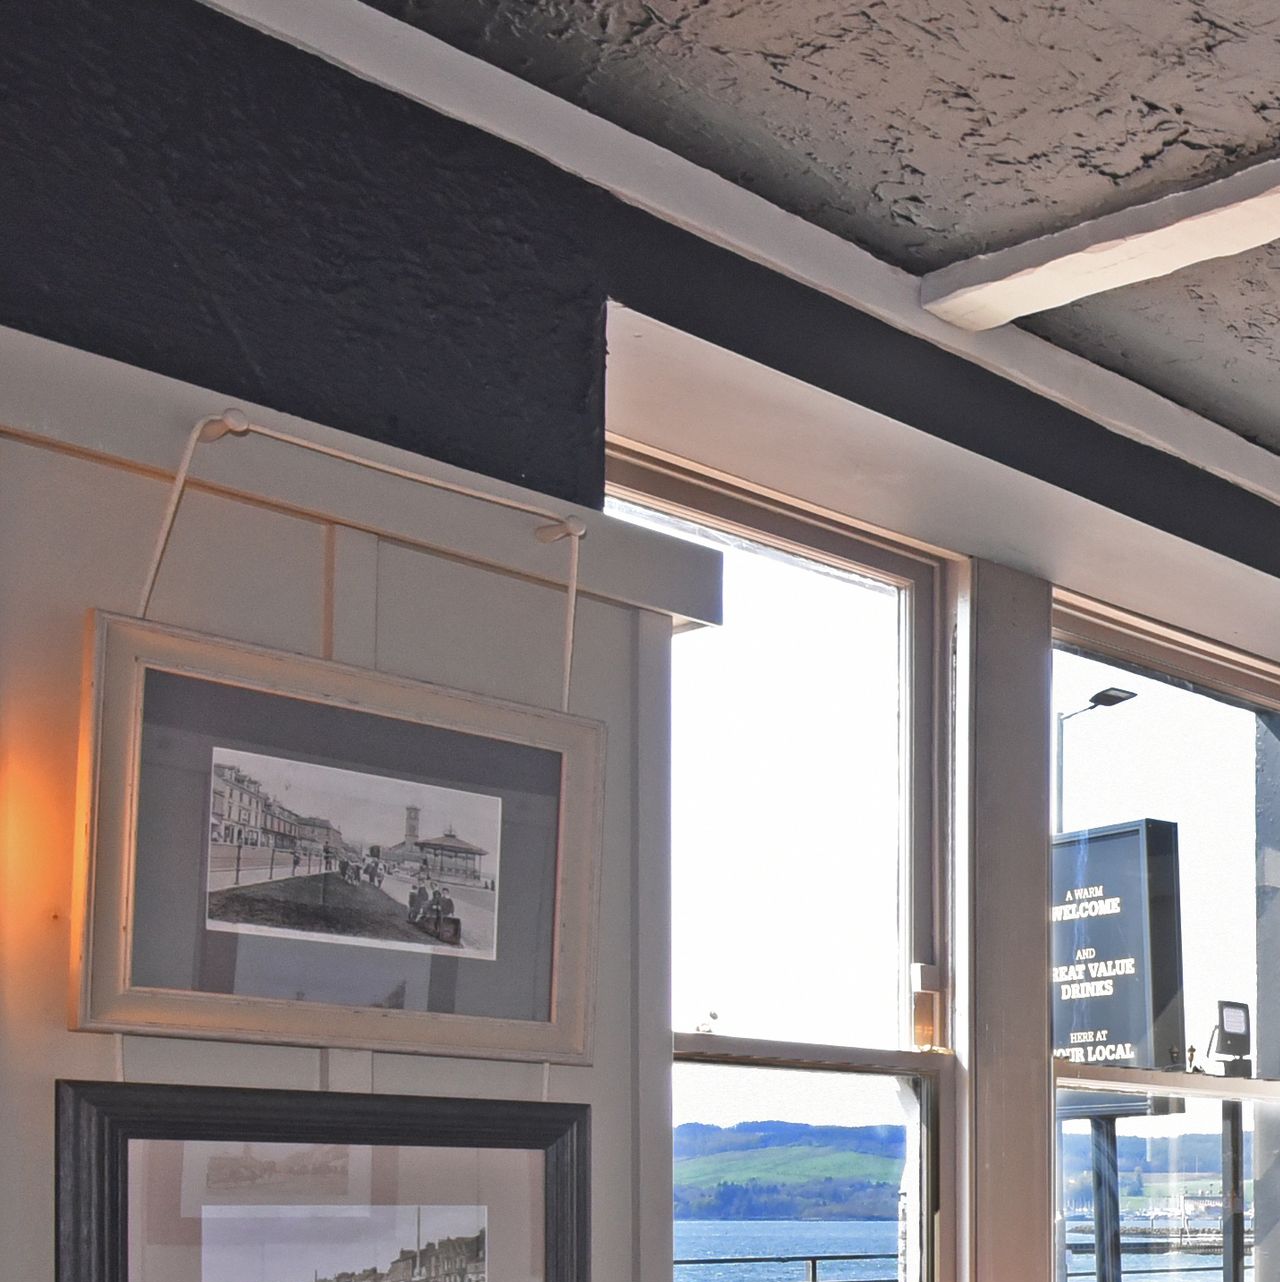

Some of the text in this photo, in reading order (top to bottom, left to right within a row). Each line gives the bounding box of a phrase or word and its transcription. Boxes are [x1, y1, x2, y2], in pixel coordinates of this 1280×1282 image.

[1065, 885, 1104, 902] A WARM
[1051, 897, 1120, 922] WELCOME
[1076, 947, 1096, 961] AND
[1053, 957, 1135, 983] REAT VALUE
[1061, 979, 1113, 1000] DRINKS
[1070, 1029, 1108, 1044] HERE AT
[1053, 1043, 1135, 1063] OUR LOCAL
